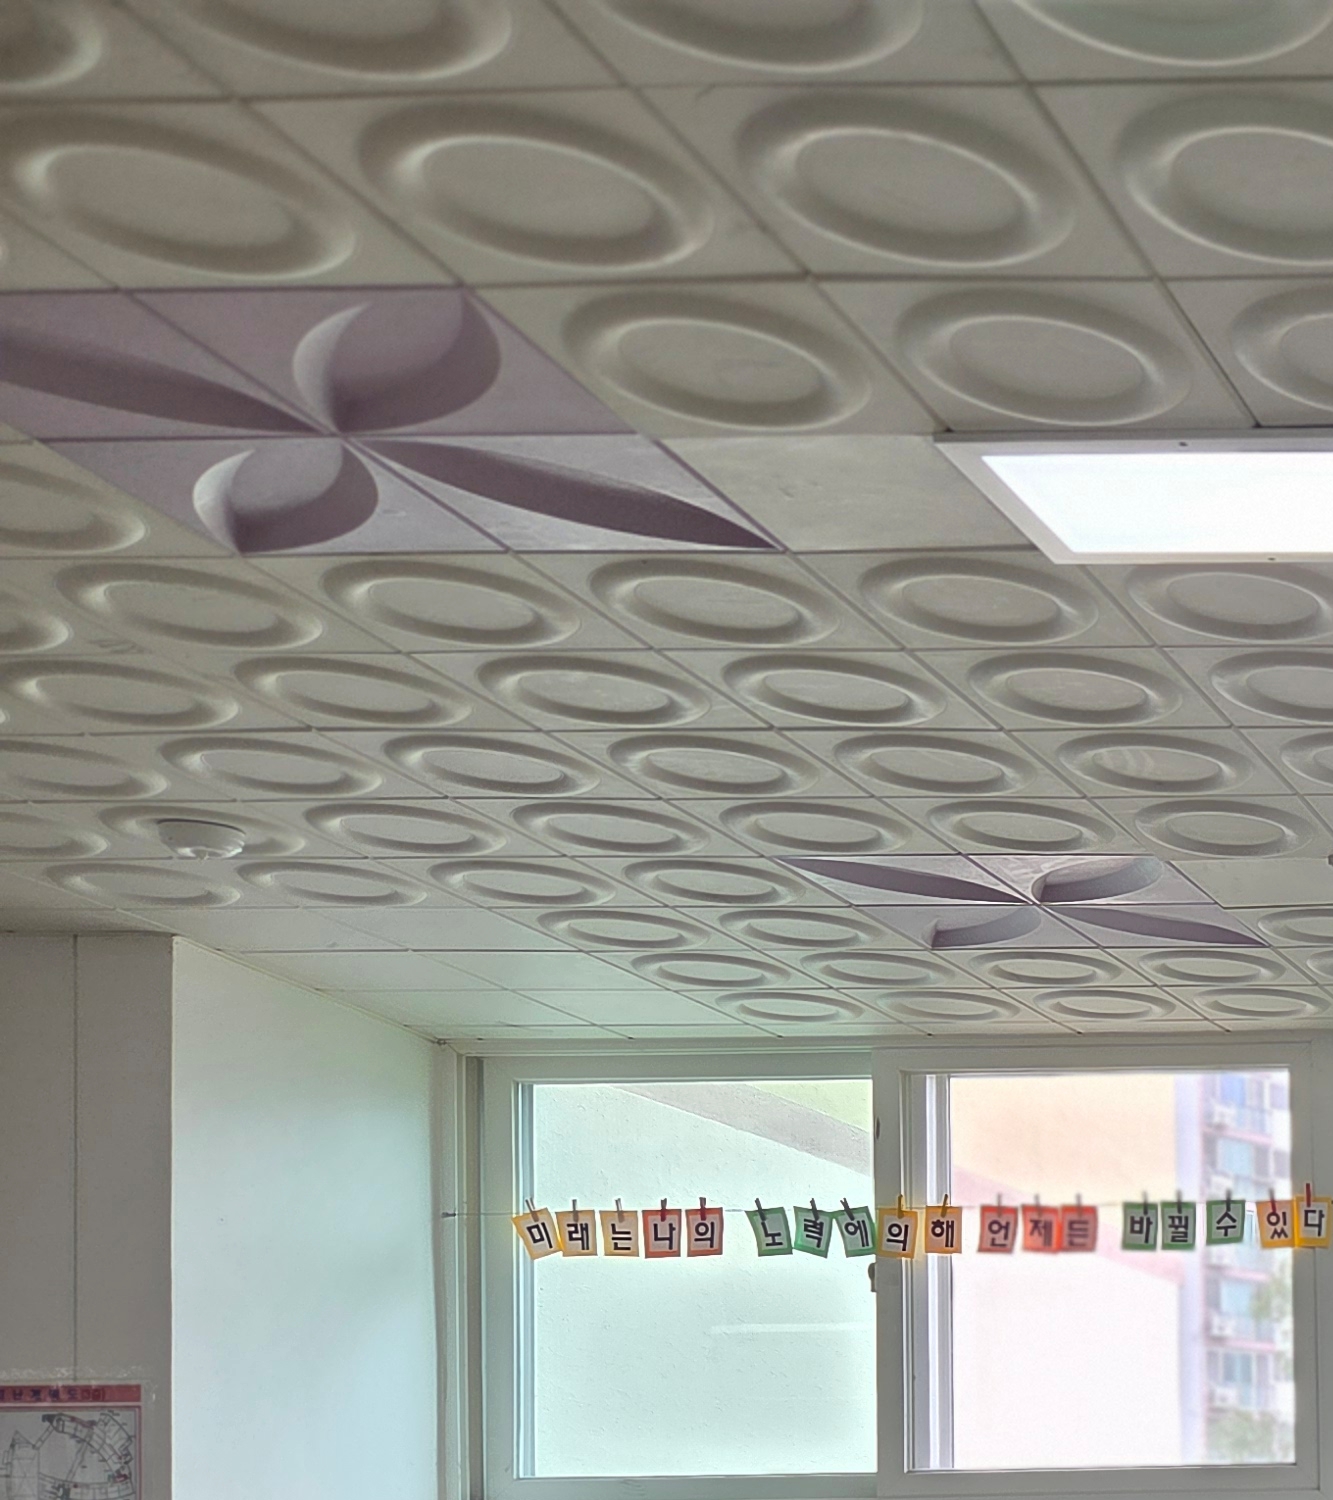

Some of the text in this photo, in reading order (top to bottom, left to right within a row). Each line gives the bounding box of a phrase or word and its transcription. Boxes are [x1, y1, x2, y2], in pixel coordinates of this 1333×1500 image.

[527, 1208, 1325, 1254] 미래는 나의 노력에 의해 언제든 바꿀 수 있다
